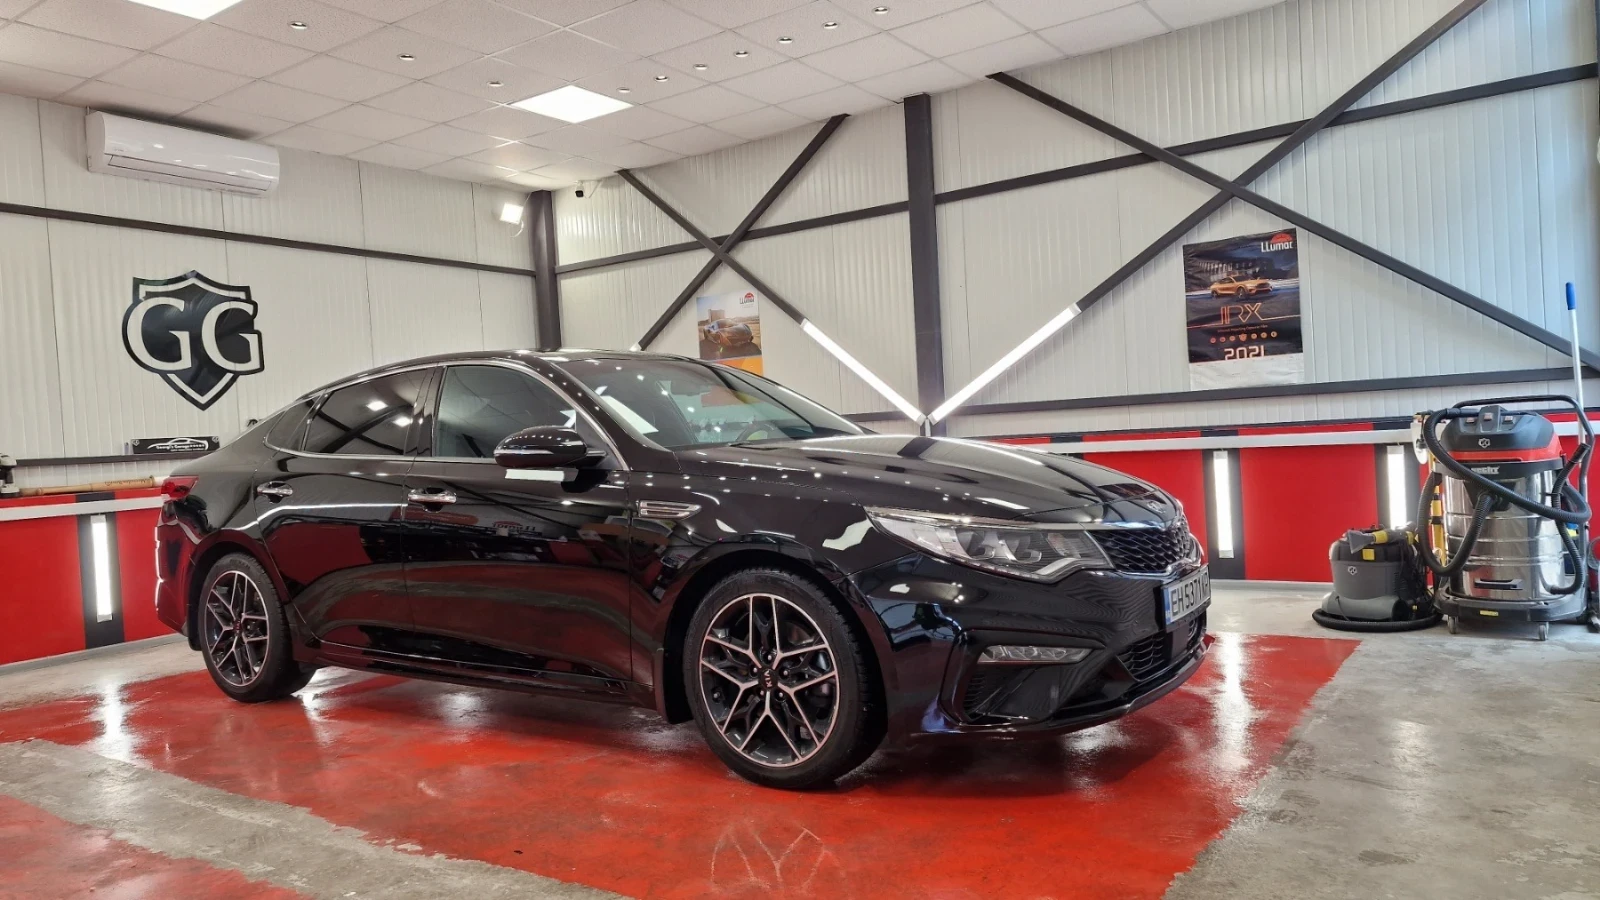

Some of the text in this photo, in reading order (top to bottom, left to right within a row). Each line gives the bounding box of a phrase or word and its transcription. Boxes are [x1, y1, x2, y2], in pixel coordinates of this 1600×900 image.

[1260, 241, 1294, 253] LLumar
[126, 296, 261, 372] GG
[1223, 344, 1266, 361] 2021
